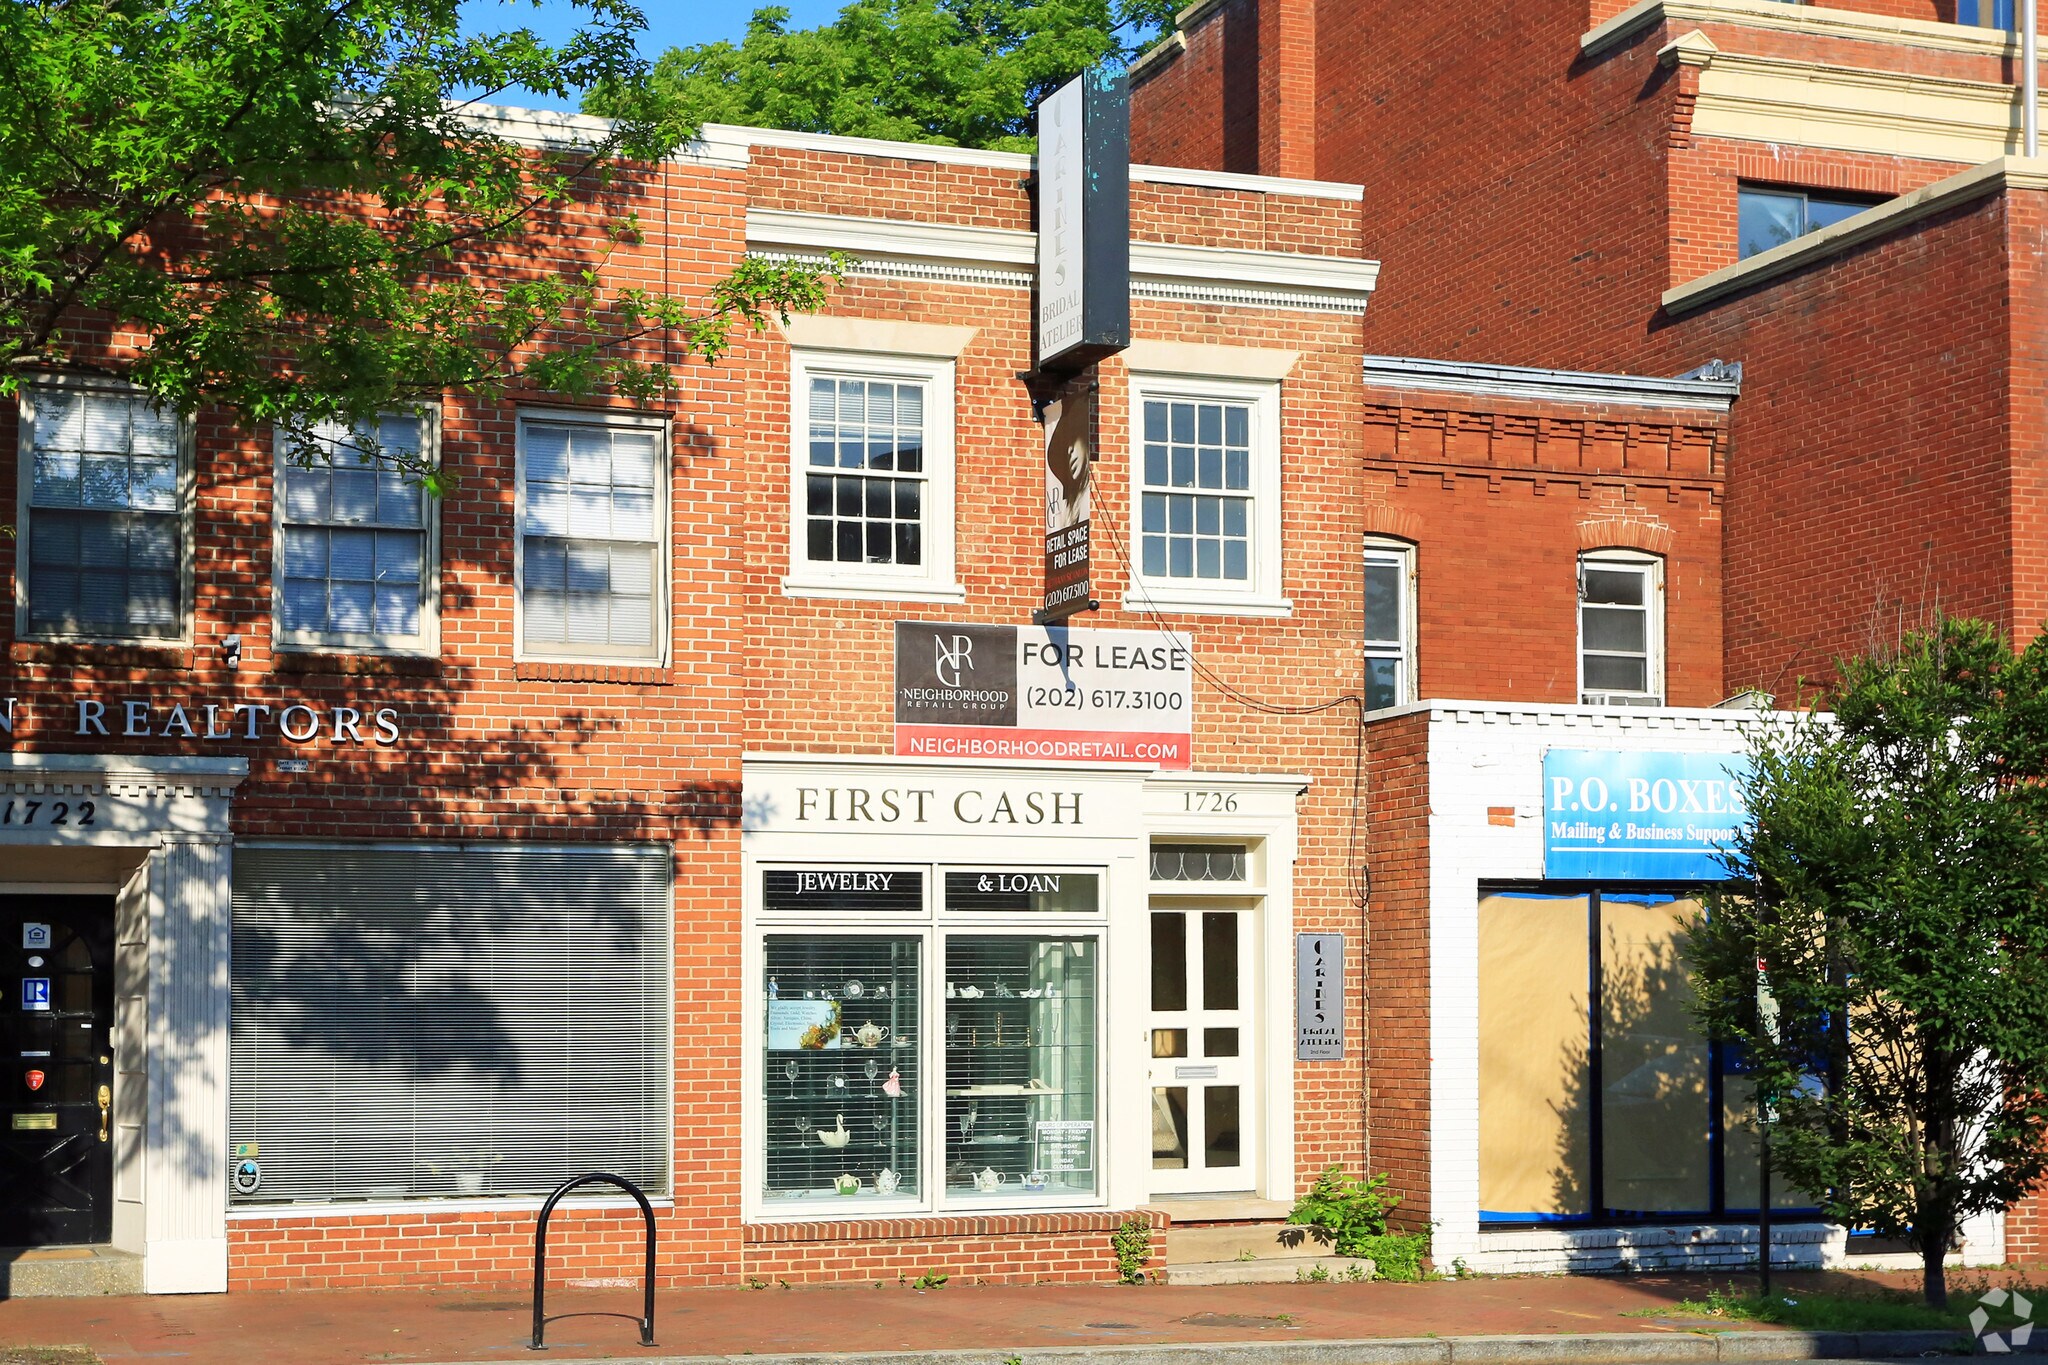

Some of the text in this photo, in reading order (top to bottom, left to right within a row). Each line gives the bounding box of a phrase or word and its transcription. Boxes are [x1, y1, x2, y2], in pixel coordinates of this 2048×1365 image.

[1042, 289, 1080, 325] BRIDAL
[1040, 314, 1083, 352] ATELIER
[1047, 525, 1087, 554] RETAIL SPACE
[1054, 544, 1087, 569] FOR LEASE
[1045, 589, 1062, 610] (202)
[1023, 642, 1185, 671] FOR LEASE
[903, 688, 1009, 703] NEIGHBORHOOD
[907, 701, 1005, 710] RETAIL GROUP
[1027, 686, 1183, 710] (202) 617.3100
[75, 699, 400, 745] REALTORS
[910, 737, 1178, 760] NEIGHBORHOODRETAIL.COM
[796, 787, 1083, 825] FIRST CASH
[1183, 792, 1238, 813] 1726
[1550, 776, 1746, 814] P.O. BOXES
[2, 801, 96, 825] 1722
[1551, 822, 1605, 843] Mailing
[1609, 822, 1622, 840] &
[1626, 823, 1682, 841] Business
[796, 872, 893, 895] JEWELRY
[977, 874, 1060, 893] & LOAN
